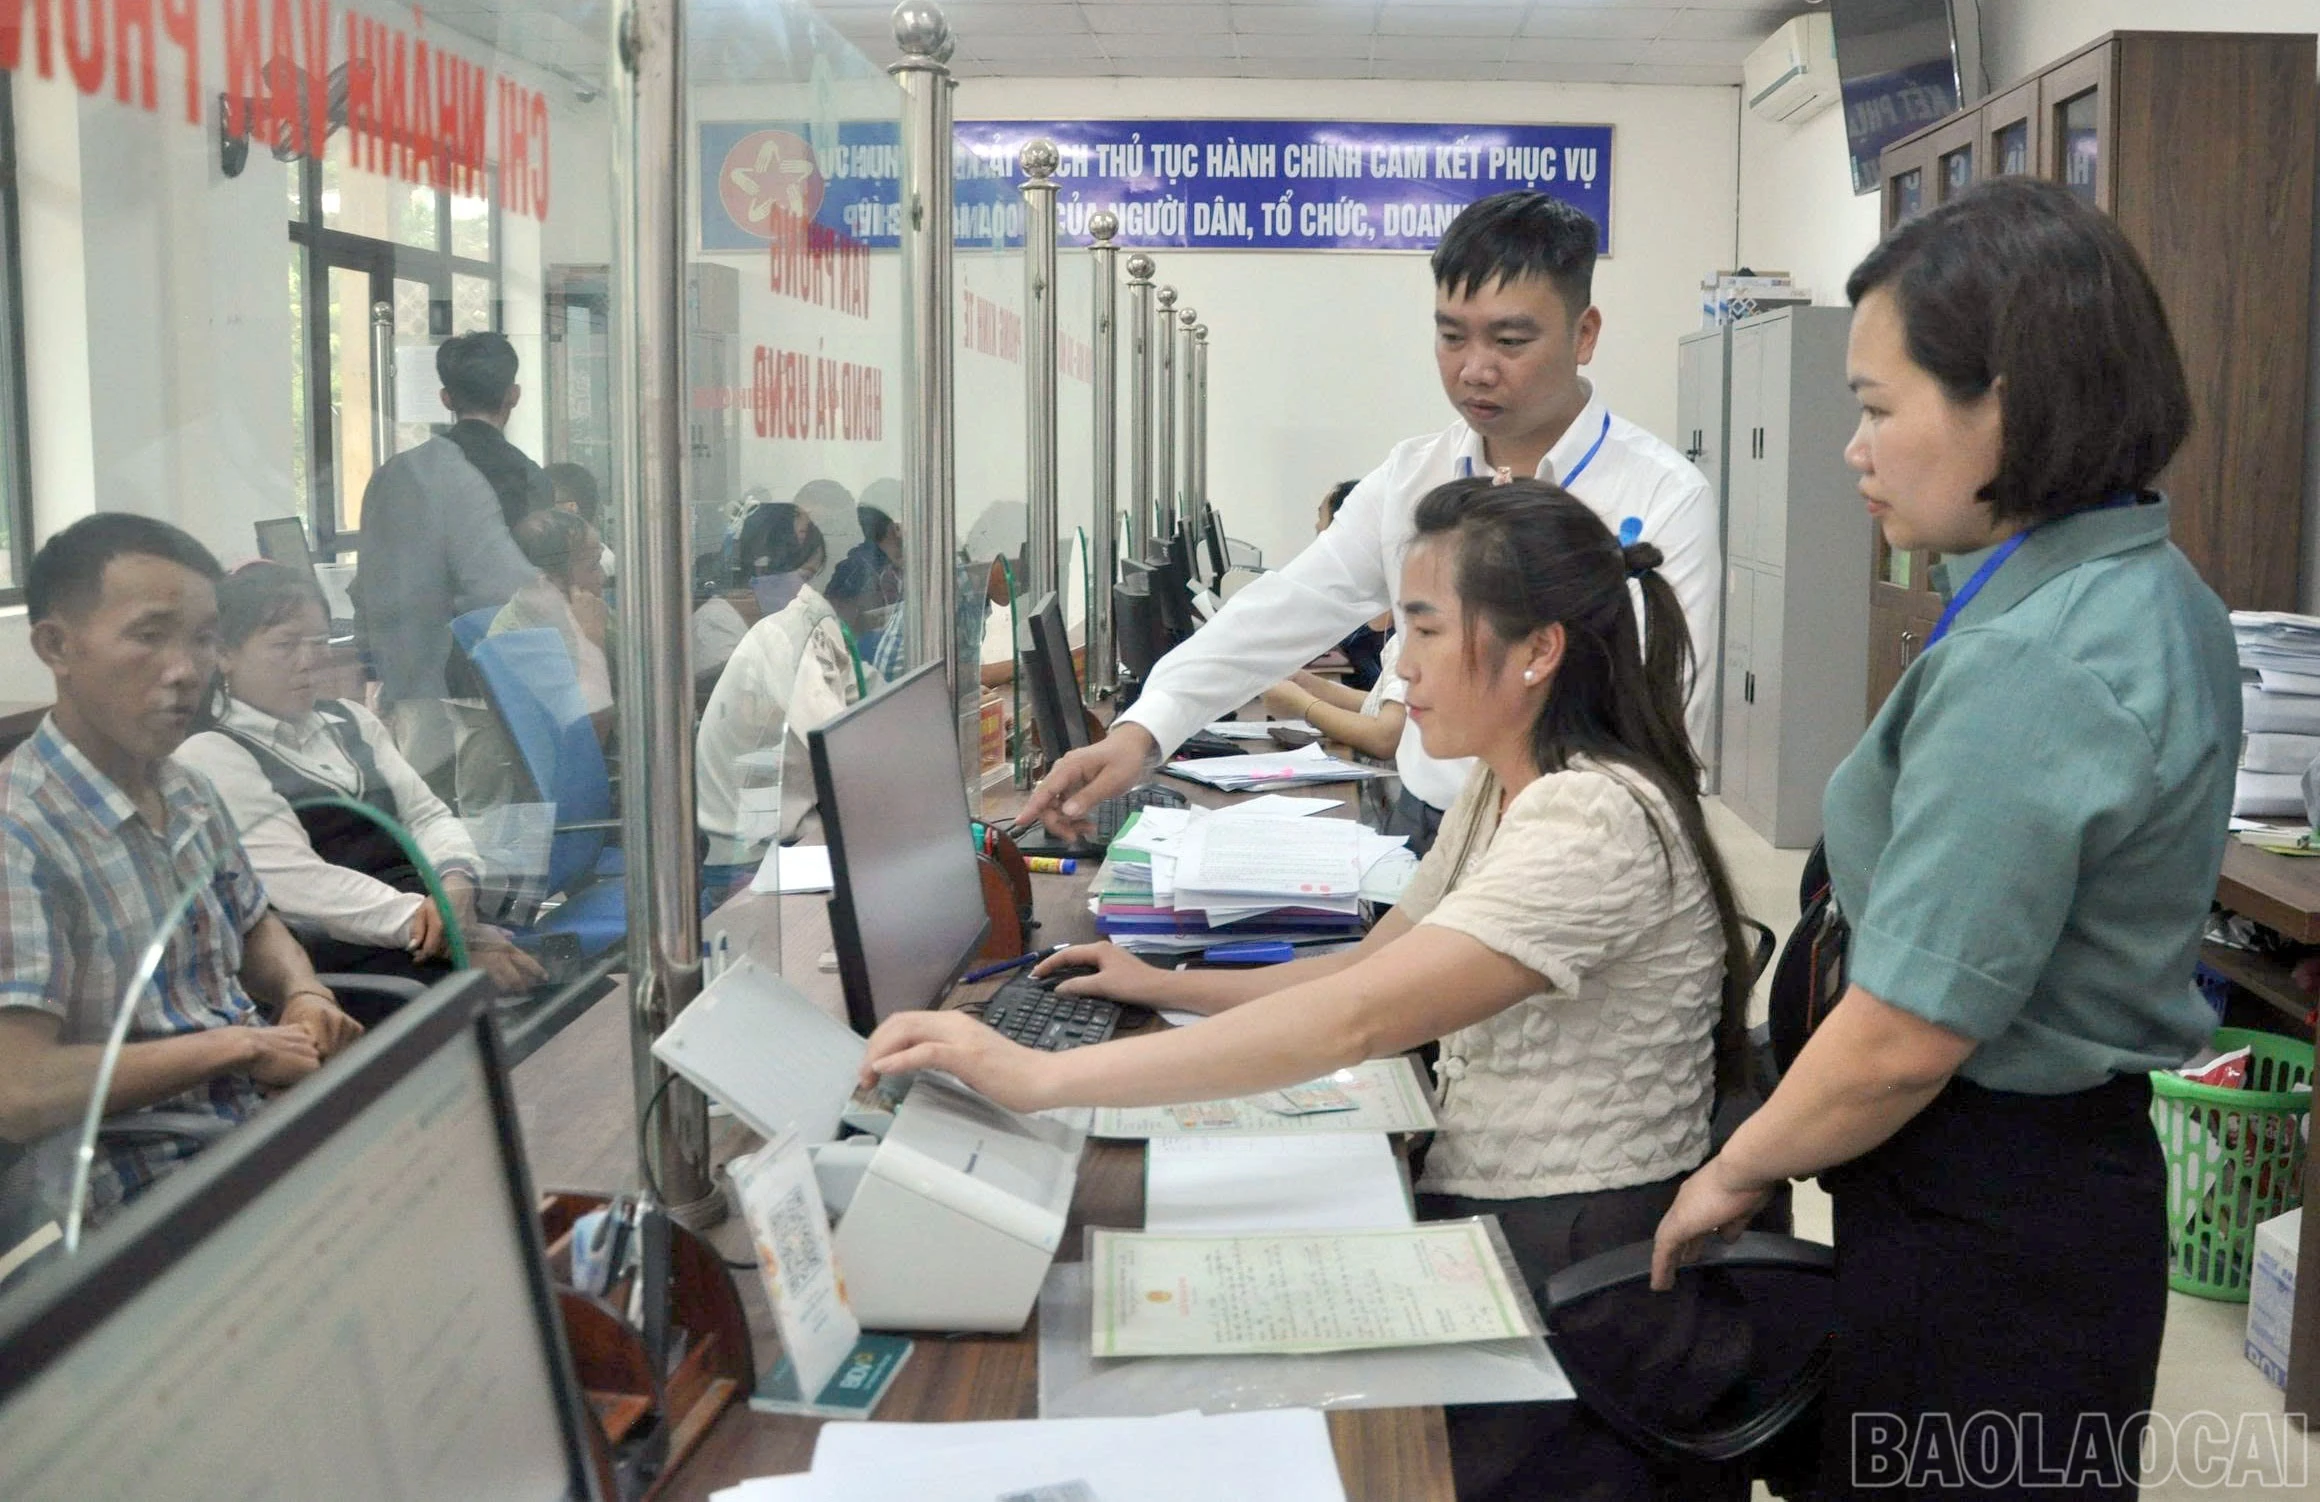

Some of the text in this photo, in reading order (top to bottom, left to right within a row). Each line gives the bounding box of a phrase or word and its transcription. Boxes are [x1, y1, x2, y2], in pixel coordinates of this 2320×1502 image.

[1096, 132, 1143, 178] THỦ
[1151, 144, 1199, 185] TỤC
[1206, 137, 1275, 178] HÀNH
[1284, 136, 1362, 179] CHÍNH
[1370, 146, 1426, 179] CAM
[1435, 135, 1482, 180] KẾT
[1489, 147, 1556, 187] PHỤC
[1565, 148, 1597, 188] VỤ
[1115, 194, 1185, 236] NGƯỜI
[1194, 198, 1254, 241] DÂN,
[1261, 189, 1293, 236] TỔ
[1301, 196, 1375, 241] CHỨC,
